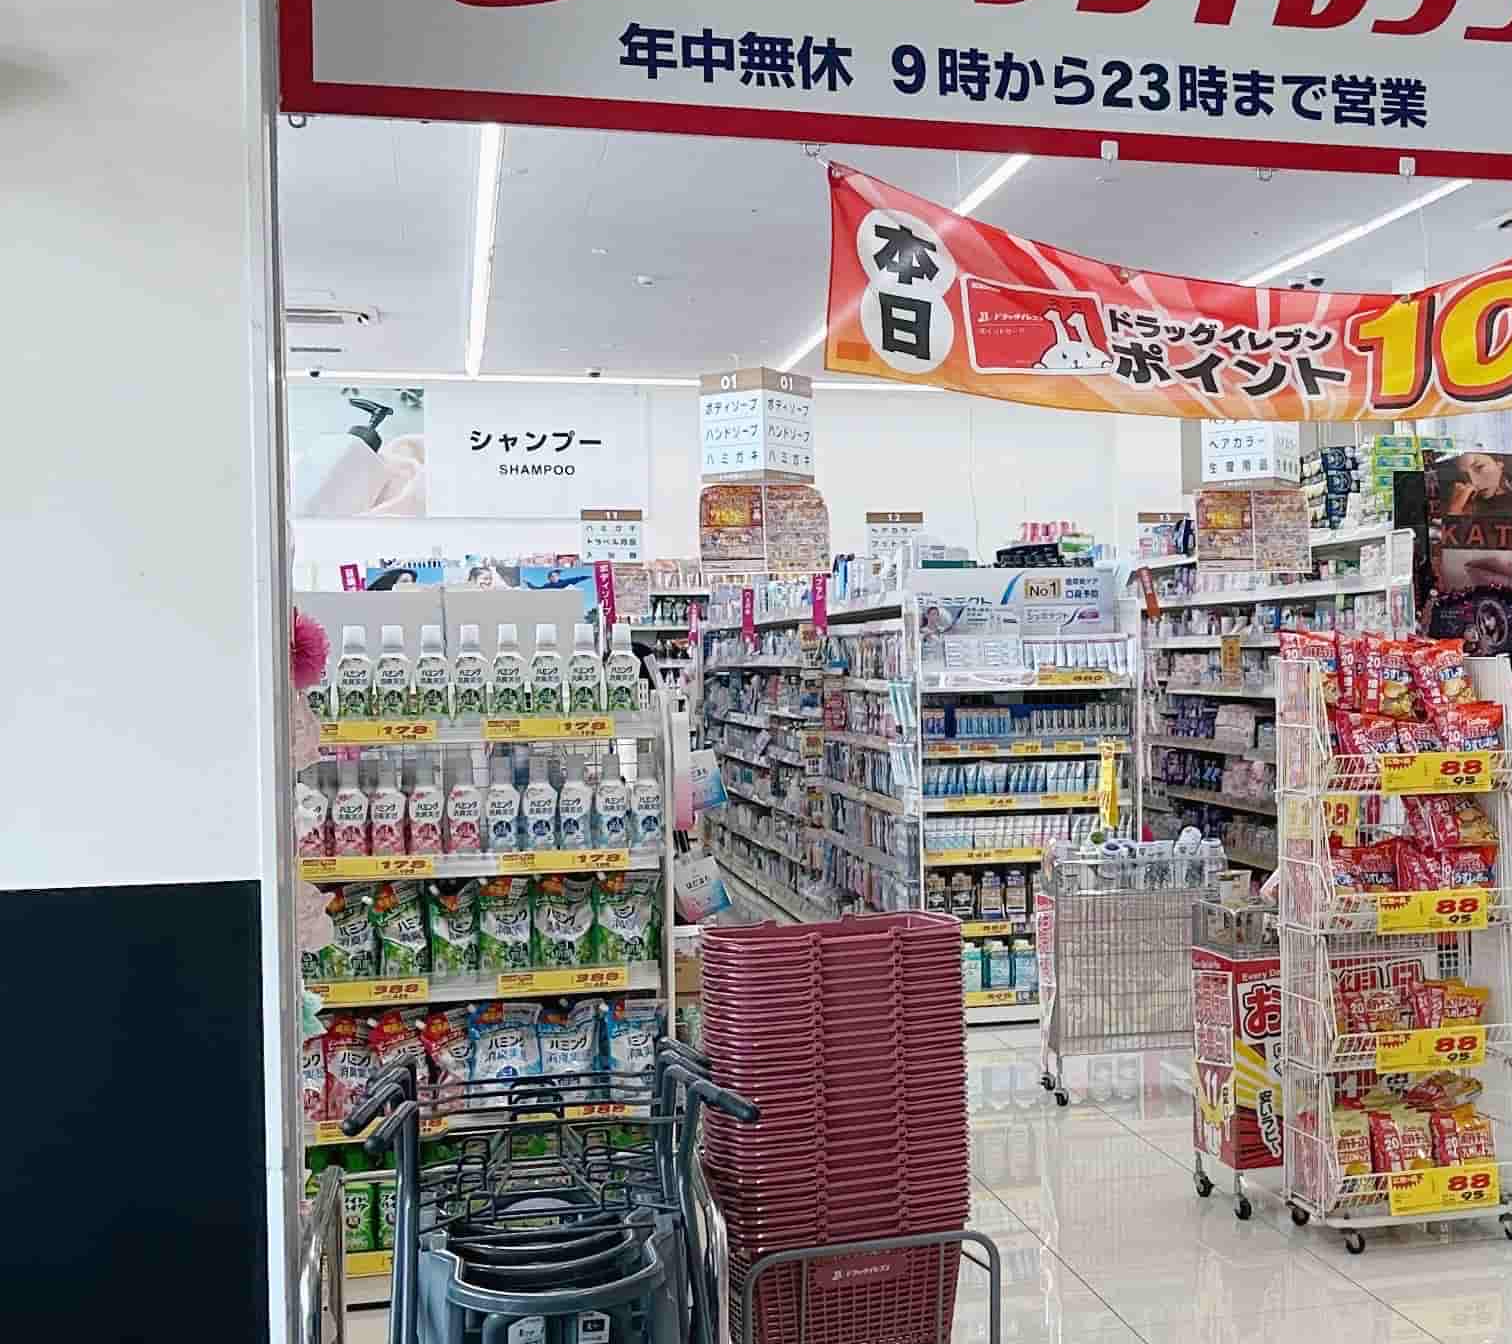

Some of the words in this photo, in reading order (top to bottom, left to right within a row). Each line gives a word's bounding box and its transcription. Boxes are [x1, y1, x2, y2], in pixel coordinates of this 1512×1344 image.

[619, 22, 854, 92] 年中無休
[891, 43, 1428, 128] 9時から23時まで営業
[873, 224, 940, 361] 本日
[1108, 308, 1333, 352] ドラッグイレブン
[1111, 341, 1346, 396] ポイント
[720, 374, 737, 389] 01
[780, 375, 793, 390] 01
[705, 424, 758, 441] ハンドソープ
[470, 429, 602, 453] シャンプー
[1208, 436, 1265, 449] ヘアカラー
[498, 464, 576, 476] SHAMPOO
[383, 725, 428, 735] 178
[563, 721, 607, 731] 178
[1439, 759, 1483, 775] 88
[1453, 776, 1476, 785] 95
[577, 853, 621, 863] 178
[1436, 897, 1479, 913] 88
[1449, 914, 1472, 923] 95
[549, 1037, 588, 1050] ハミング
[1434, 1036, 1478, 1051] 88
[1447, 1051, 1470, 1061] 95
[1447, 1173, 1491, 1191] 88
[1461, 1191, 1484, 1201] 95
